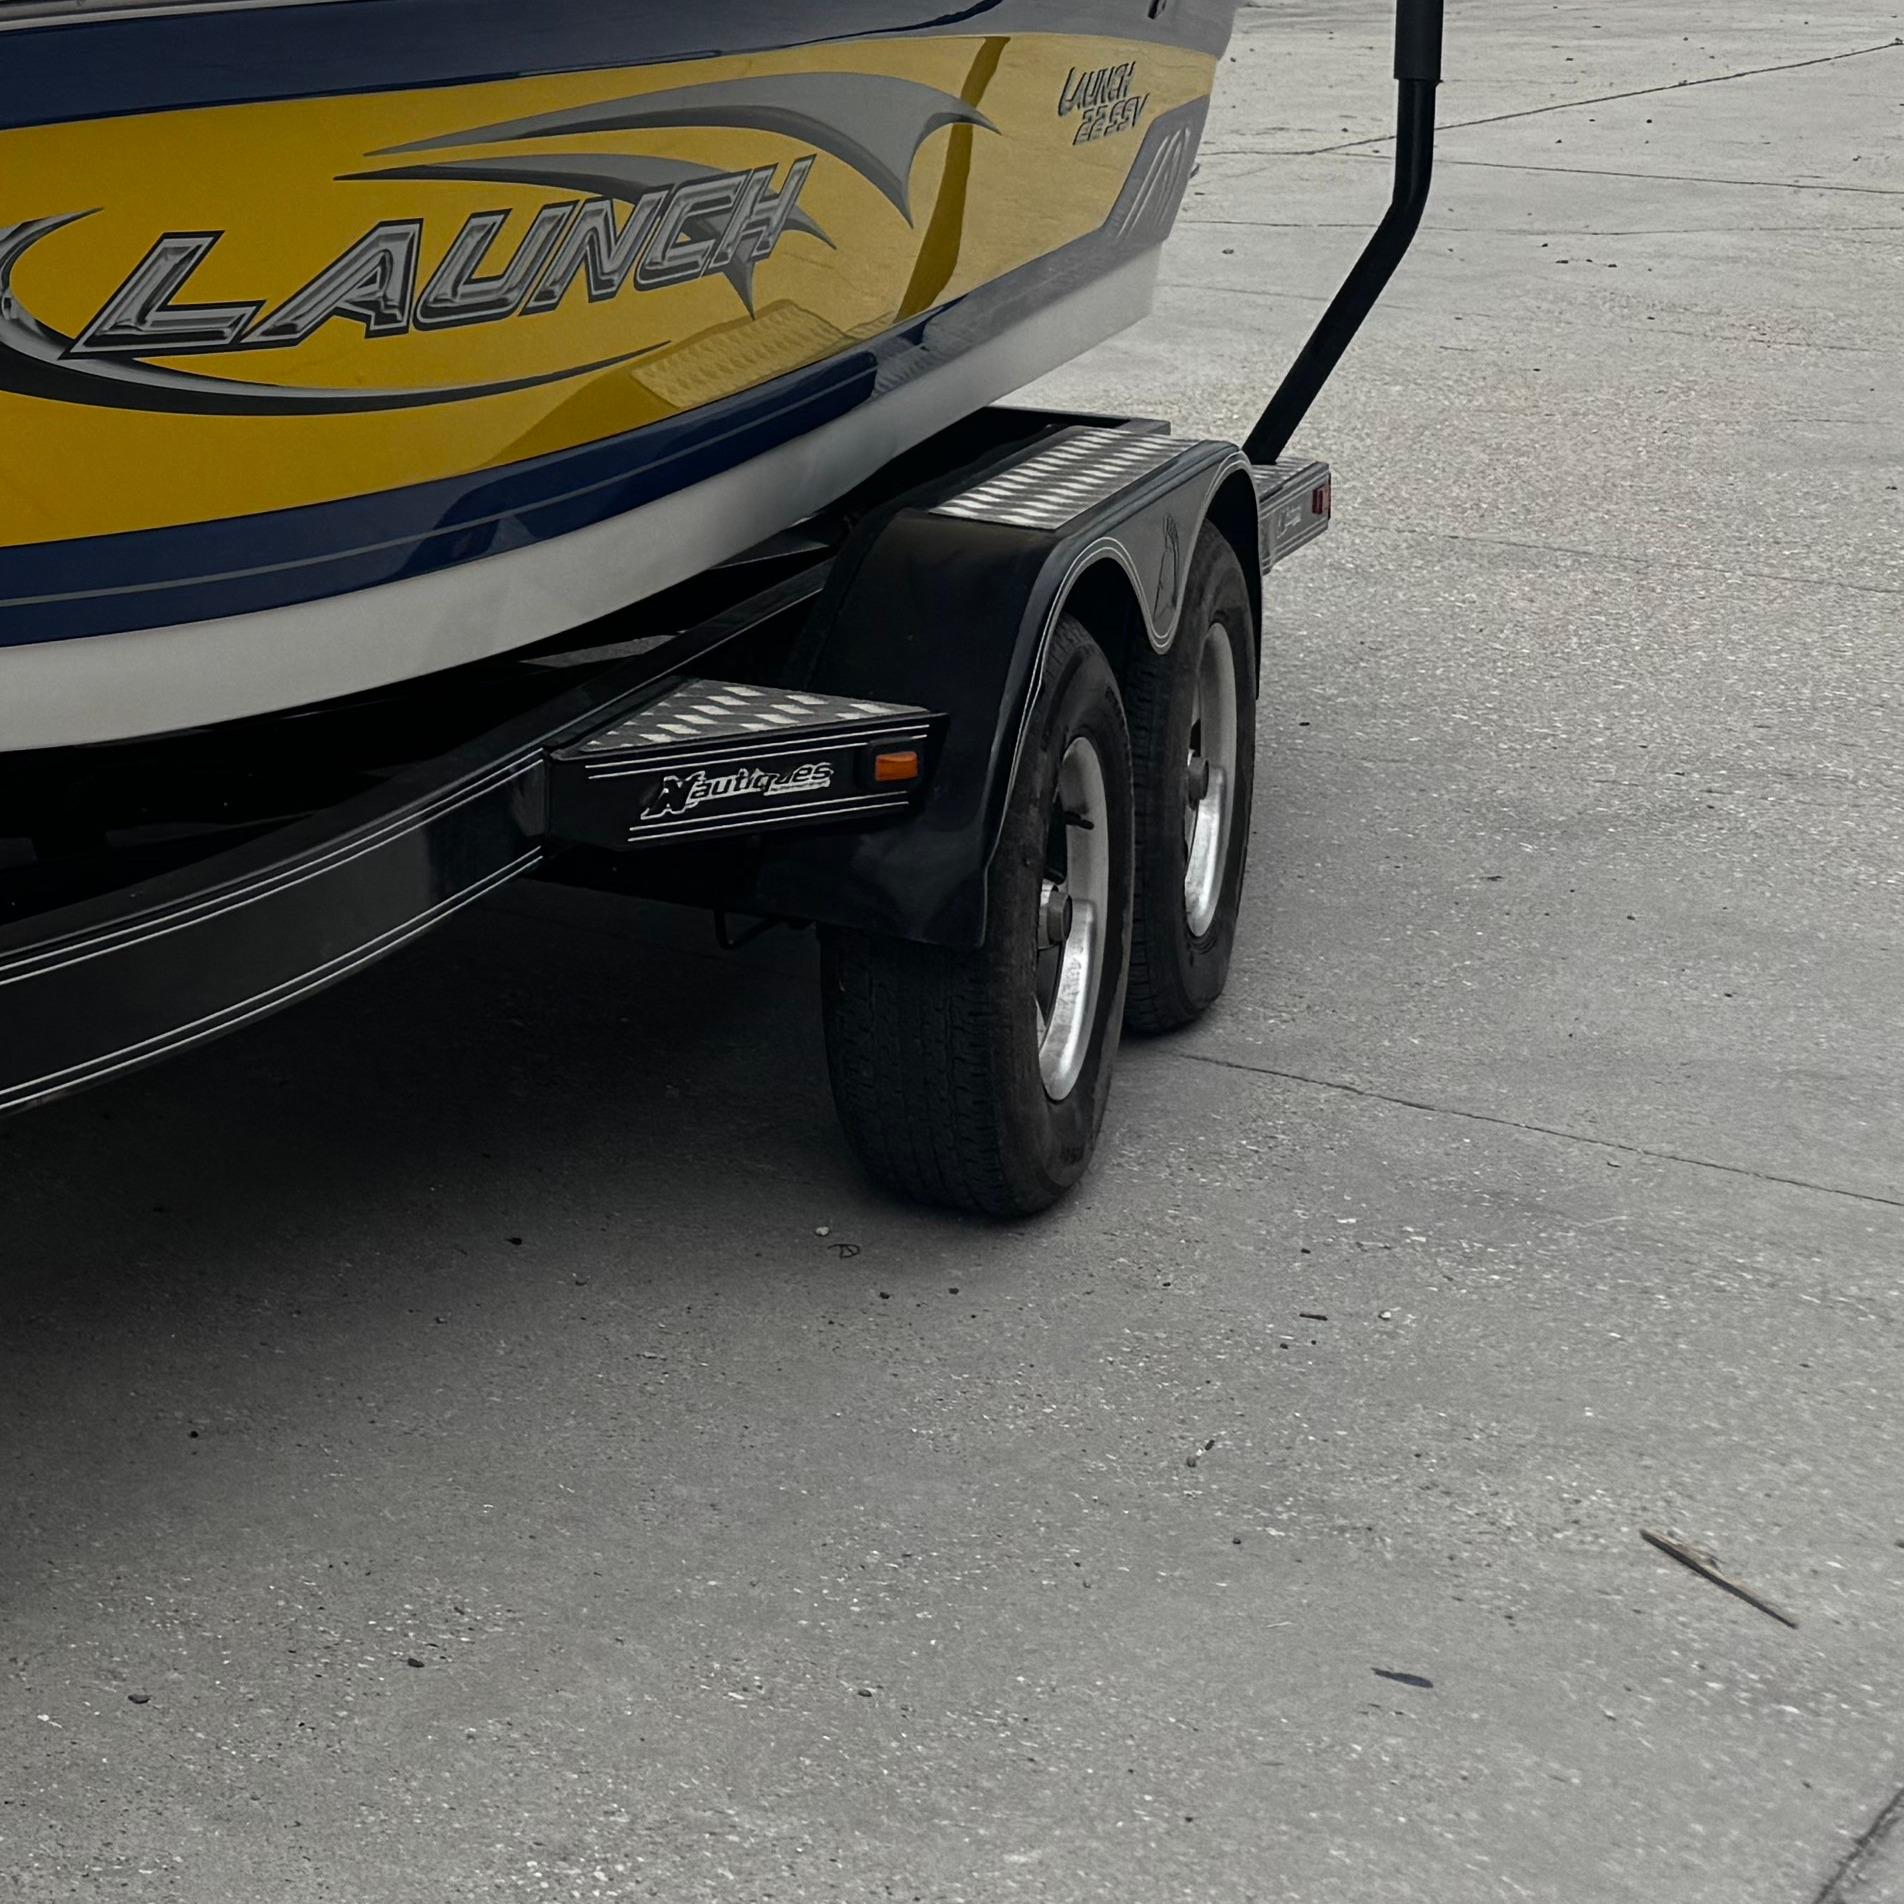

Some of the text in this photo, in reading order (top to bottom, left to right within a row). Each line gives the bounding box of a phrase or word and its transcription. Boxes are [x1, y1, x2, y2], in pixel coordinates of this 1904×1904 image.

[1058, 61, 1136, 116] LAUNCH
[63, 155, 815, 358] LAUNCH
[640, 761, 833, 820] Nautiques
